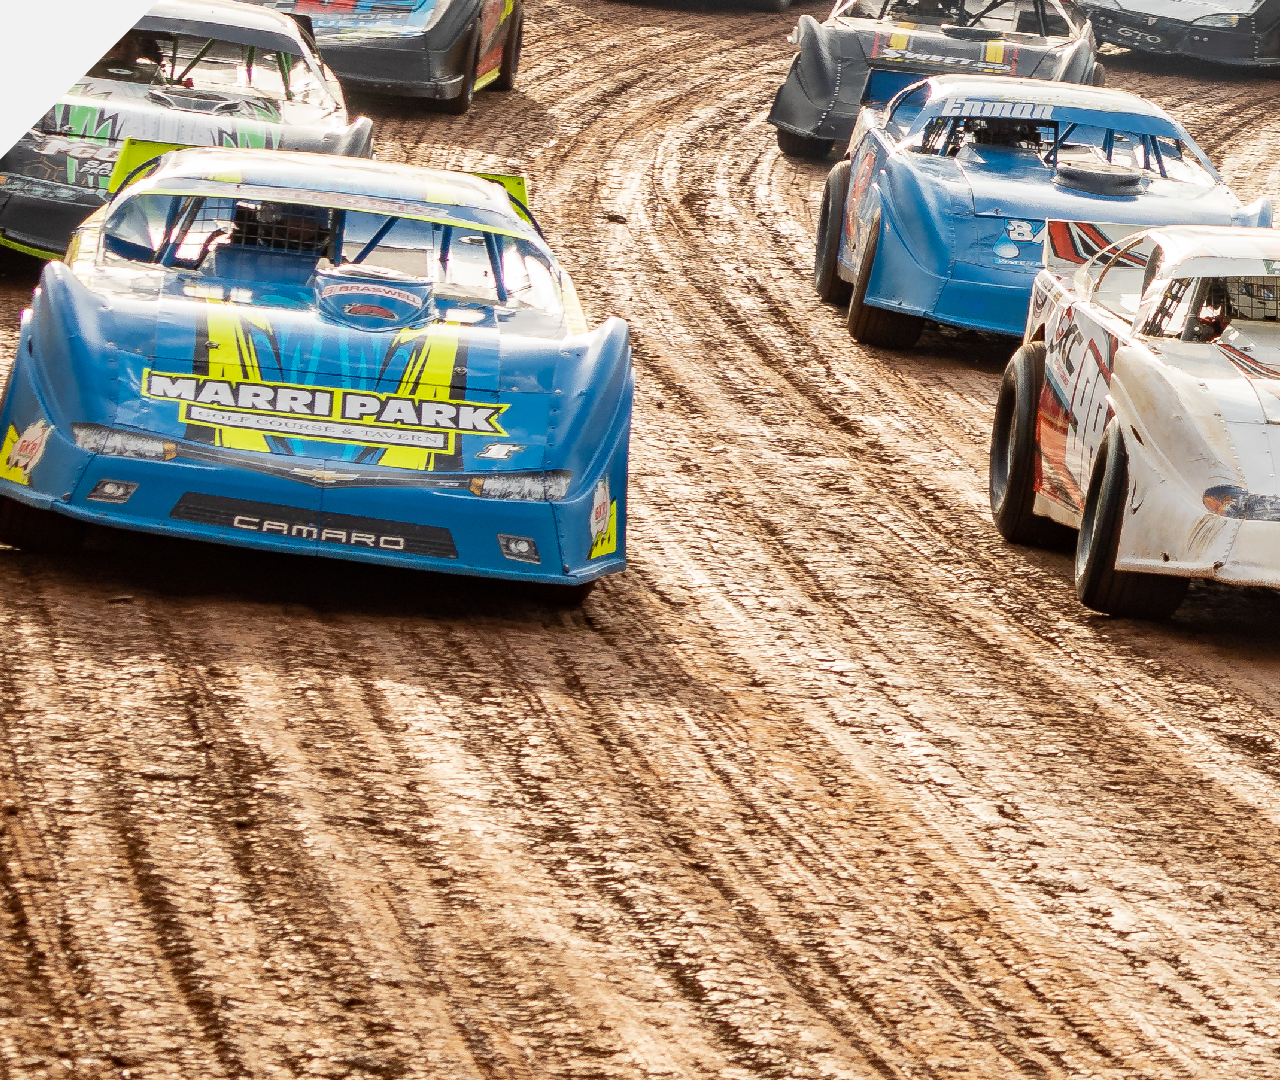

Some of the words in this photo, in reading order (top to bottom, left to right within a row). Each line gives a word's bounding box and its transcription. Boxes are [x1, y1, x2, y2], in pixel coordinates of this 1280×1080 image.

[338, 284, 419, 305] BRASWELL
[151, 375, 331, 416] MARRI
[345, 391, 502, 432] PARK
[198, 410, 250, 425] GOLF
[255, 416, 337, 433] COURSE
[342, 425, 359, 437] &
[364, 428, 441, 446] TAVERN
[233, 515, 405, 550] CAMARO
